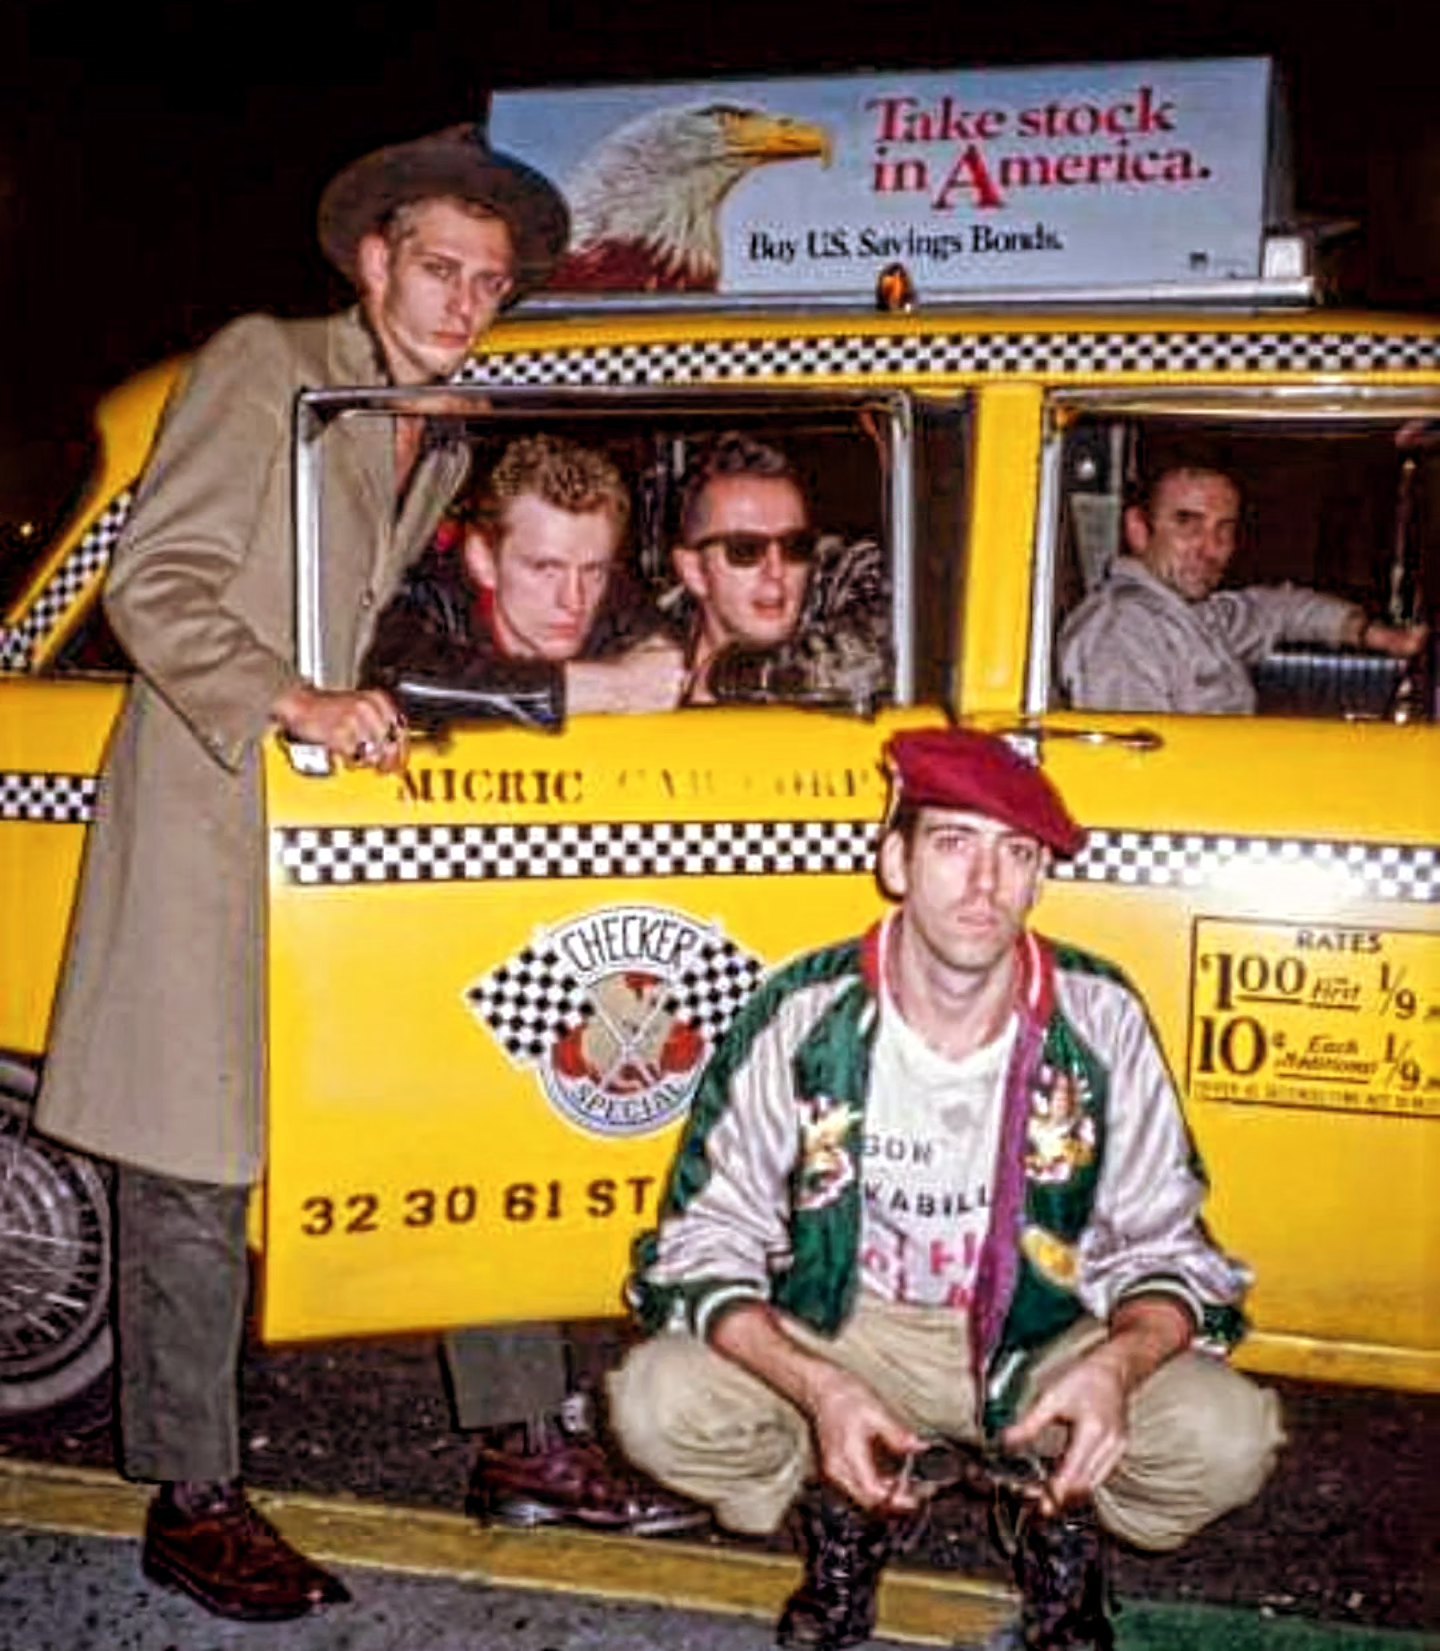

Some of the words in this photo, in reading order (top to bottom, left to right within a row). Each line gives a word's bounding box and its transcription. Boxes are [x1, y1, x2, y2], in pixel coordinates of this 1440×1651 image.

[866, 97, 1007, 143] Take
[1017, 86, 1176, 138] stock
[873, 148, 927, 192] in
[931, 138, 1212, 211] America.
[749, 231, 796, 262] Buy
[858, 226, 963, 260] Savings
[971, 222, 1065, 253] Bonds.
[398, 768, 583, 804] MICRIC
[560, 914, 699, 972] CHECKER
[1296, 930, 1382, 954] RATES
[1309, 1034, 1359, 1053] Each
[574, 1082, 688, 1120] SPECIAL
[301, 1193, 379, 1235] 32
[403, 1184, 477, 1226] 30
[503, 1180, 561, 1221] 61
[585, 1173, 655, 1217] ST
